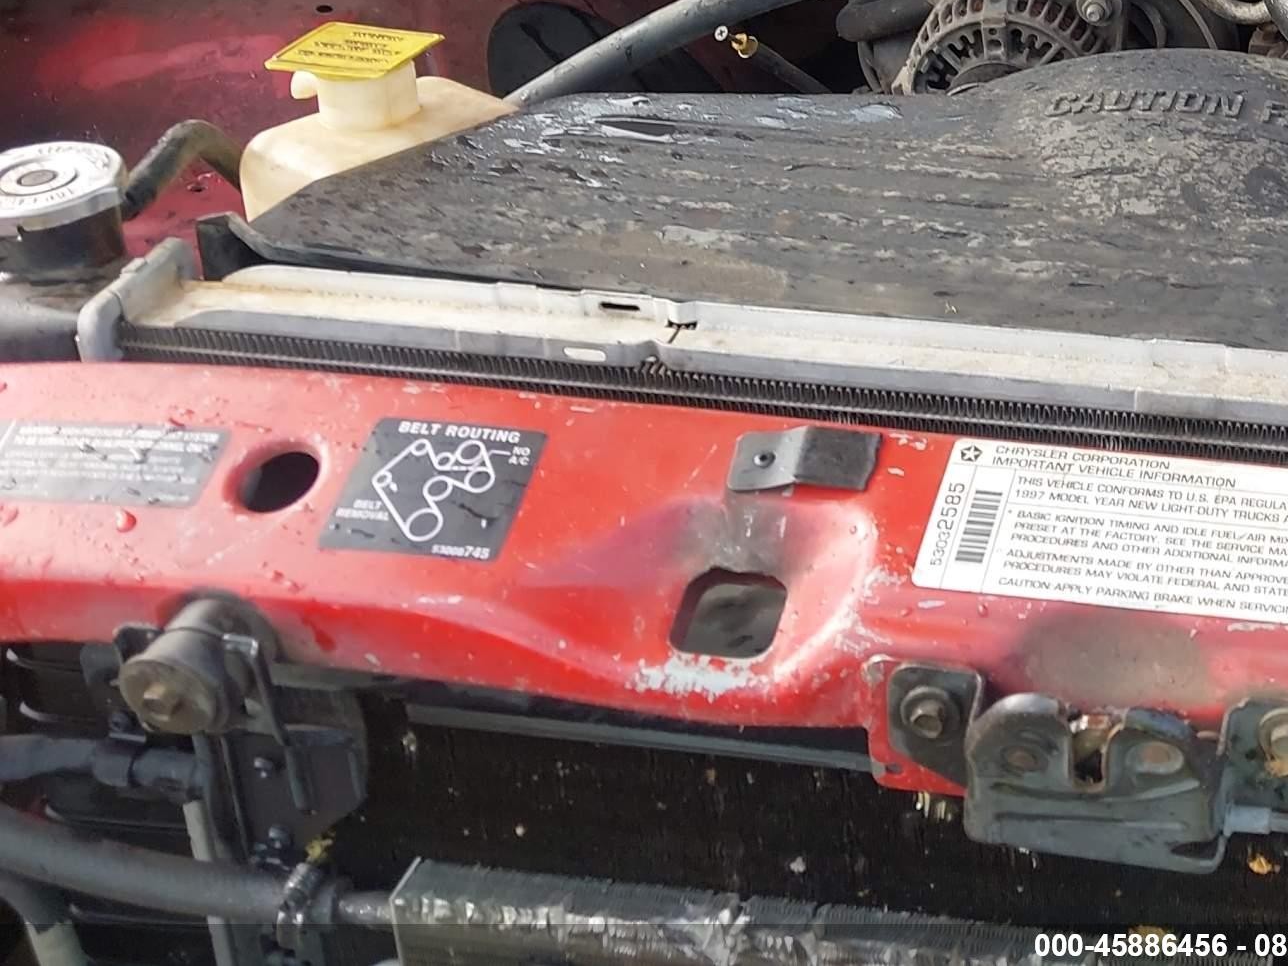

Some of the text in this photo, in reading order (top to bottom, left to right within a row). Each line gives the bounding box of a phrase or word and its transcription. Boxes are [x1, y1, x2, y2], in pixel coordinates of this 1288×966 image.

[1045, 89, 1245, 119] CAUTION
[398, 421, 520, 443] BELT ROUTING
[509, 456, 529, 466] A/C
[513, 446, 530, 456] NO
[996, 445, 1170, 469] CHRYSLER CORPORATION
[992, 457, 1236, 488] IMPORTANT VEHICLE INFORMATION
[353, 499, 382, 510] BELT
[1015, 489, 1044, 500] 1997
[1049, 492, 1089, 504] MODEL
[1094, 496, 1124, 508] YEAR
[1129, 499, 1157, 511] NEW
[1234, 509, 1280, 523] TRUCKS
[1018, 476, 1043, 487] THIS
[1047, 479, 1093, 492] VEHICLE
[1098, 484, 1164, 498] CONFORMS
[1168, 490, 1181, 501] TO
[1186, 491, 1209, 504] U.S.
[1214, 494, 1237, 506] EPA
[335, 509, 389, 521] REMOVAL
[930, 482, 965, 566] 53032585
[1017, 511, 1051, 521] BASIC
[1055, 514, 1104, 526] IGNITION
[1109, 519, 1150, 531] TIMING
[1154, 522, 1179, 534] AND
[1183, 526, 1207, 537] IDLE
[1011, 533, 1088, 548] PROCEDURES
[1092, 542, 1118, 551] AND
[1122, 544, 1160, 555] OTHER
[1164, 548, 1233, 563] ADDITIONAL
[1014, 522, 1057, 534] PRESET
[1061, 526, 1076, 534] AT
[1080, 527, 1100, 537] THE
[1165, 538, 1188, 546] SEE
[1191, 538, 1212, 549] THE
[1216, 542, 1264, 554] SERVICE
[1003, 561, 1081, 576] PROCEDURES
[1085, 569, 1113, 578] MAY
[1117, 572, 1163, 584] VIOLATE
[1168, 576, 1220, 590] FEDERAL
[1224, 583, 1250, 593] AND
[1007, 549, 1093, 565] ADJUSTMENTS
[1098, 558, 1132, 569] MADE
[1156, 564, 1194, 575] OTHER
[1200, 568, 1231, 579] THAN
[999, 577, 1051, 590] CAUTION
[1054, 583, 1092, 595] APPLY
[1096, 587, 1150, 601] PARKING
[1154, 592, 1193, 605] BRAKE
[1198, 596, 1235, 609] WHEN
